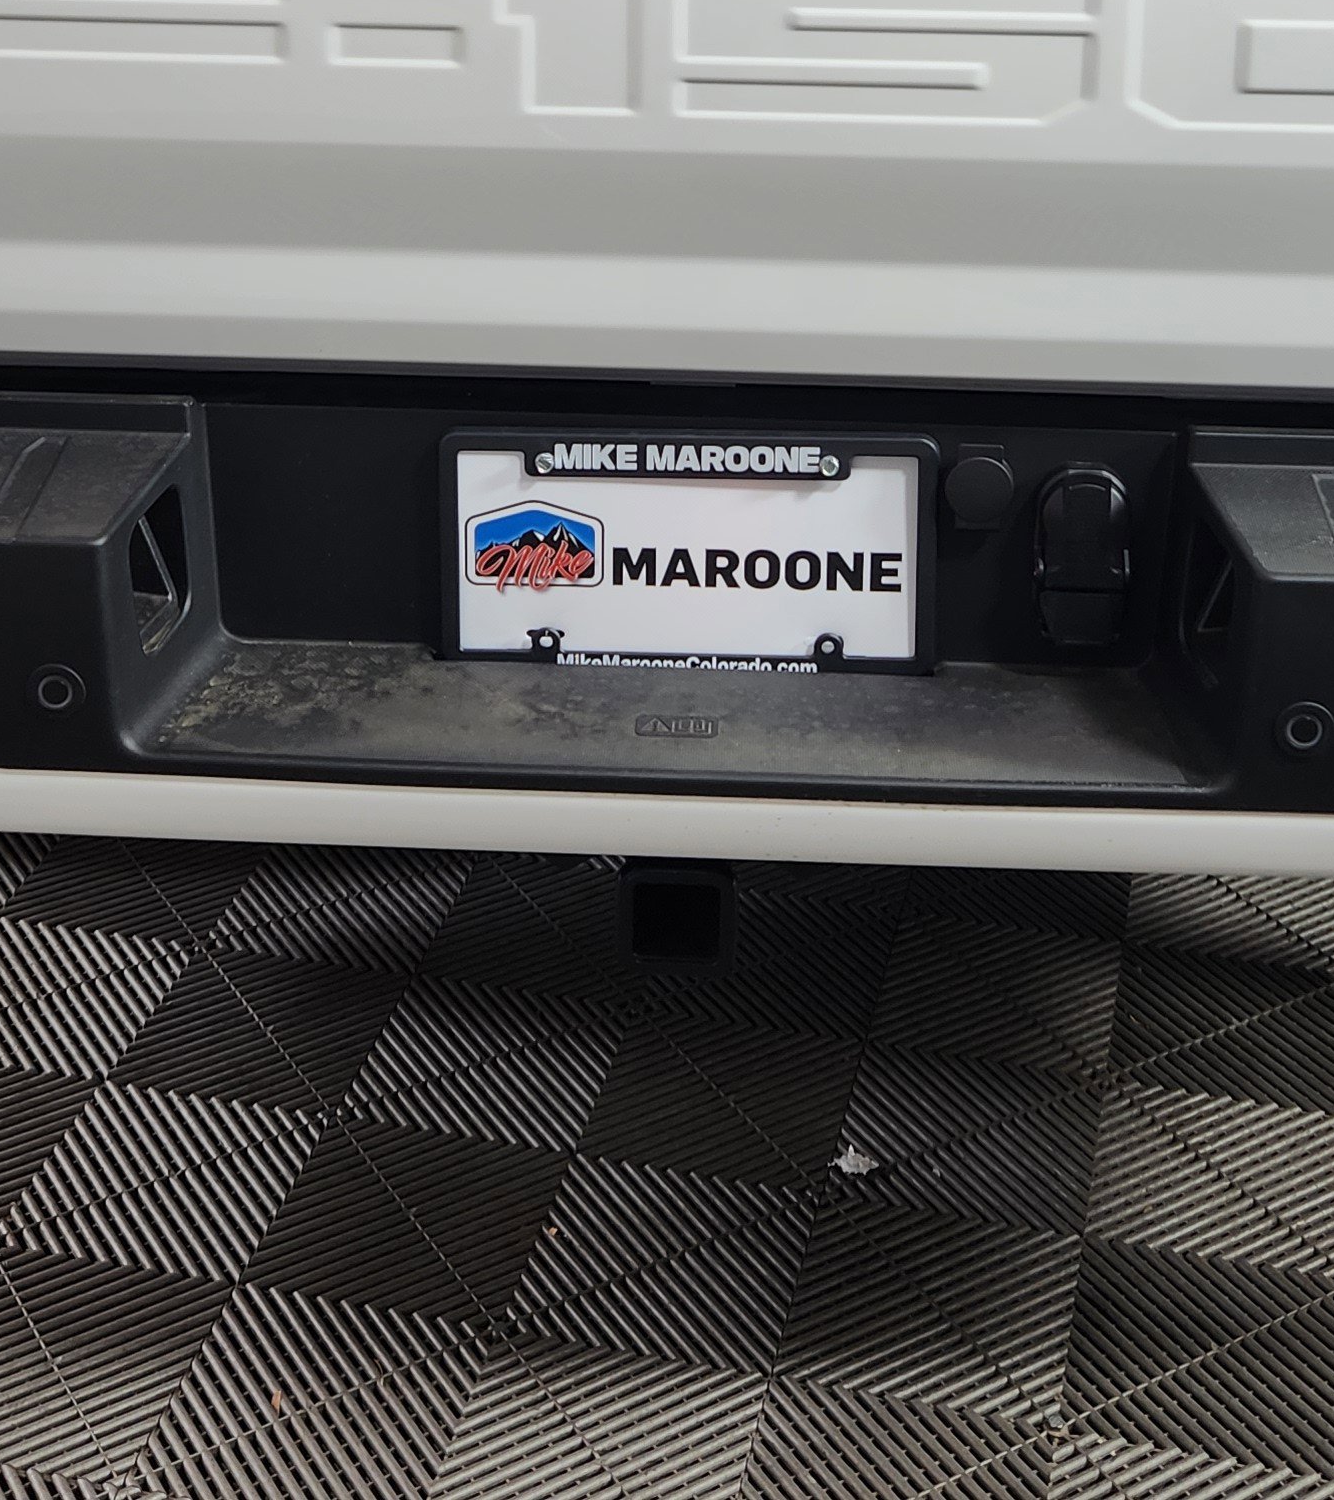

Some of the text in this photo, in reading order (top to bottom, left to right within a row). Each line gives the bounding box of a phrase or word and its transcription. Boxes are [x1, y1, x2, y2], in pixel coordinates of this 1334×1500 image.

[554, 443, 821, 474] MIKE MAROONE
[475, 540, 903, 593] Mike MAROONE
[556, 653, 818, 673] MikeMarooneColoradocom
